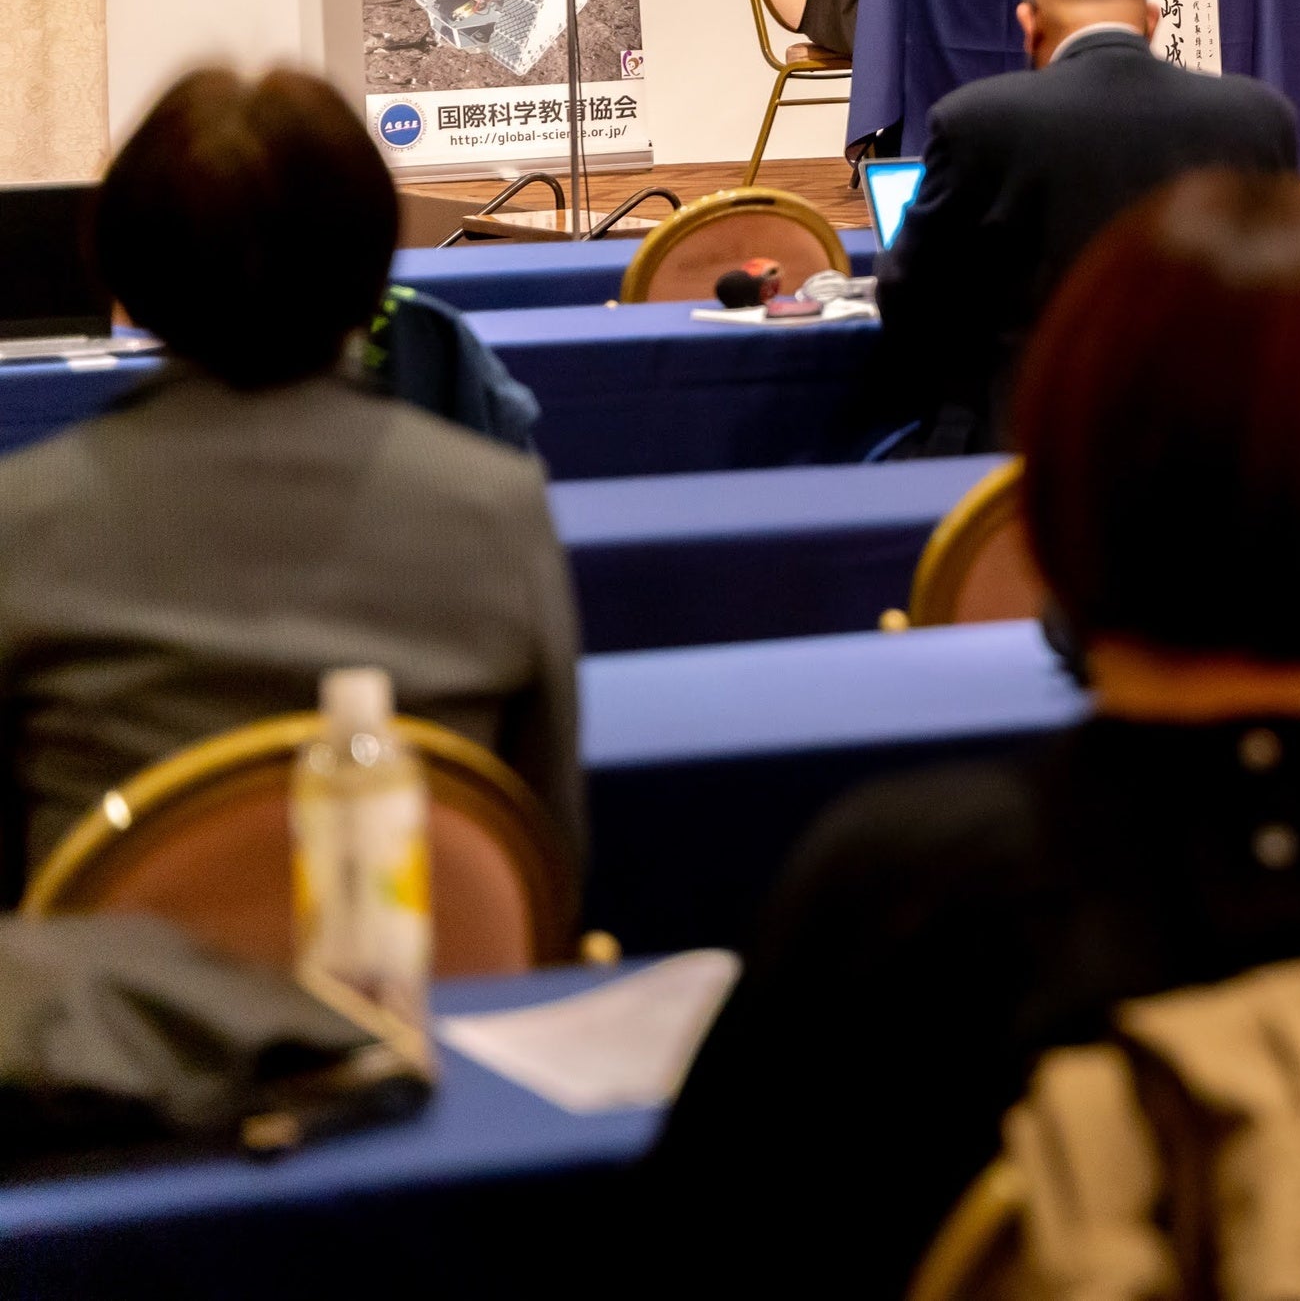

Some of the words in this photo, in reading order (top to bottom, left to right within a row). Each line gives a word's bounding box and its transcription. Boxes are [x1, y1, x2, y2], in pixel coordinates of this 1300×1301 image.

[437, 94, 638, 130] 国際科学教育協会
[449, 125, 628, 148] http://global-sciee.or.jp/
